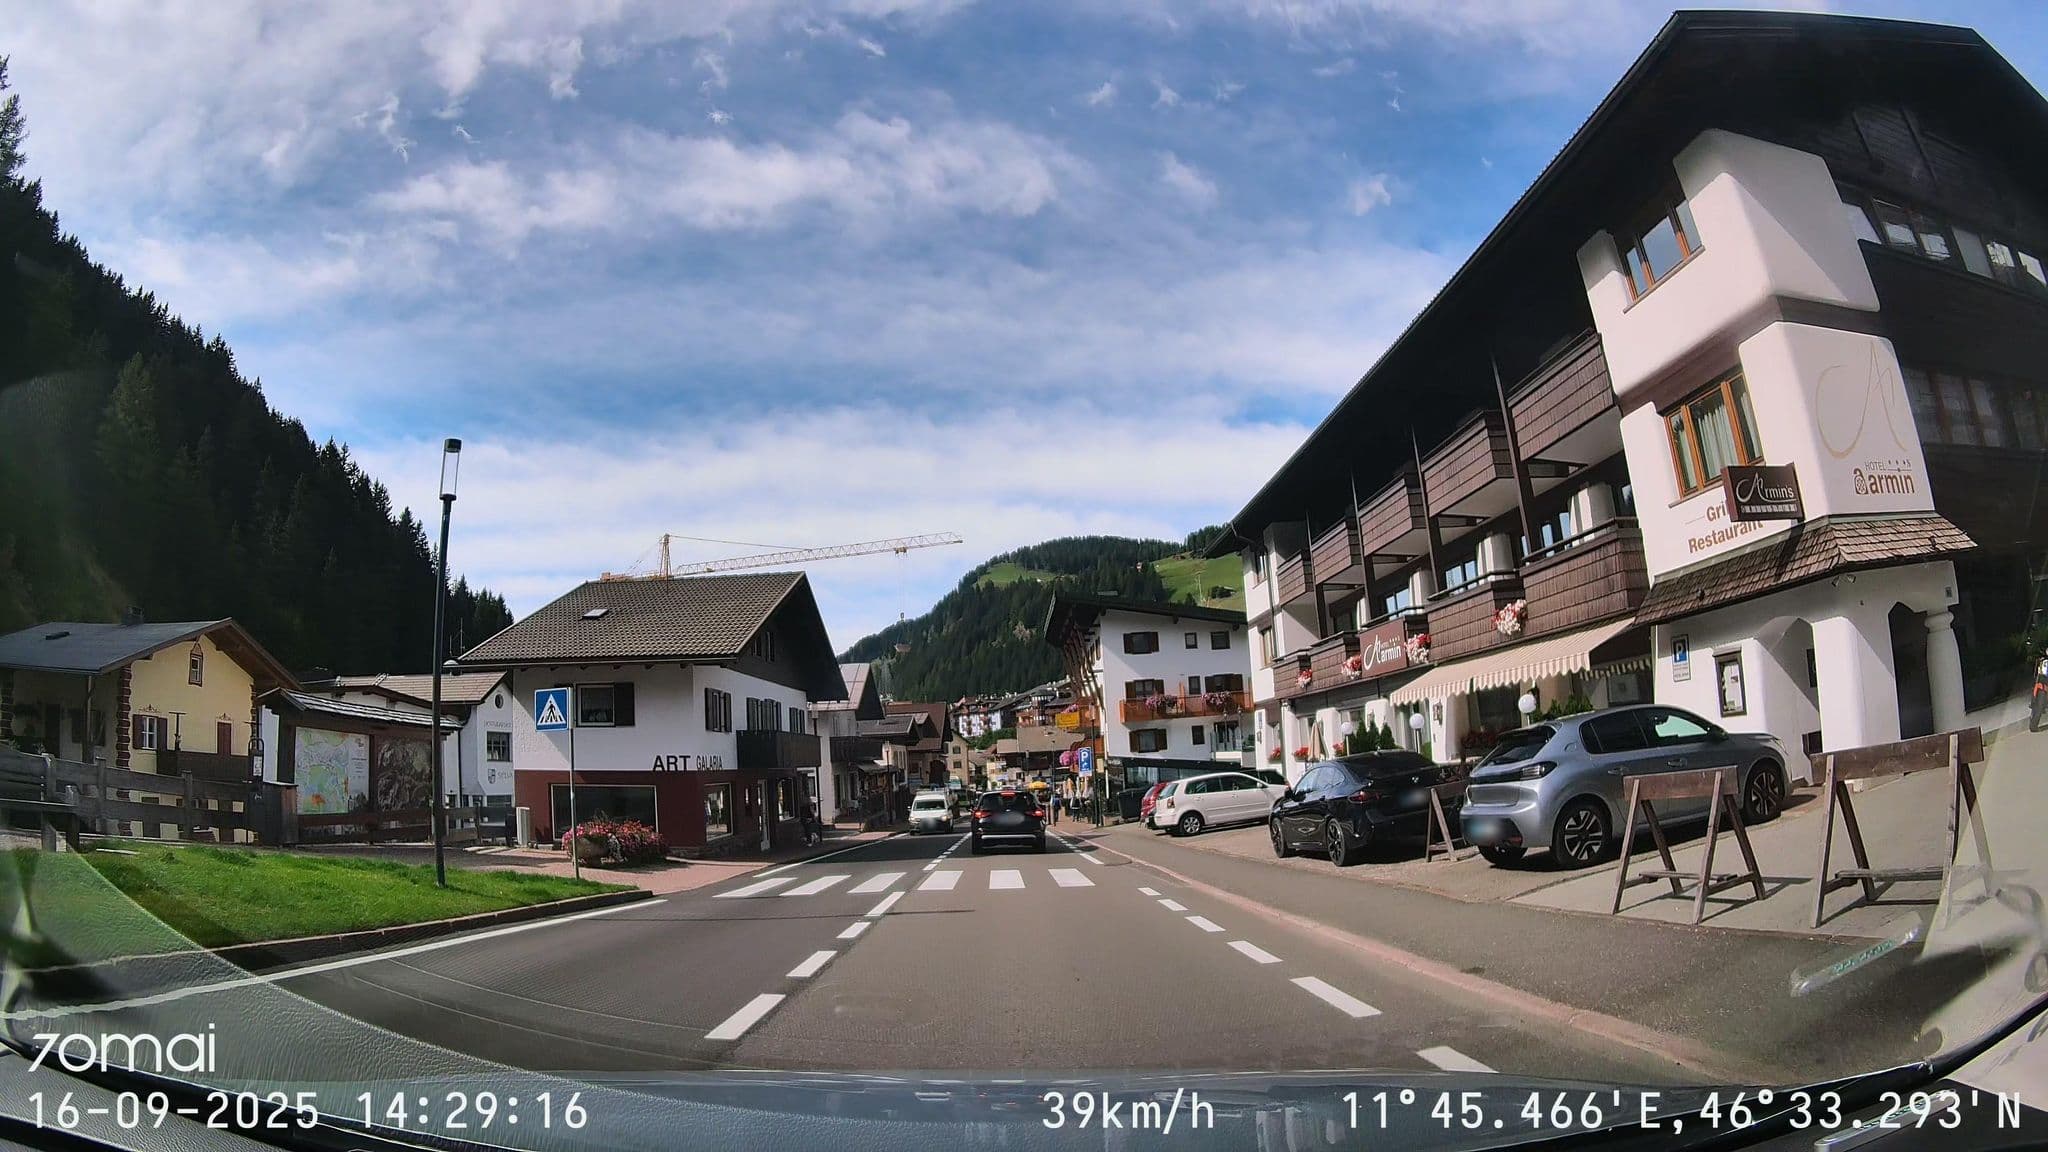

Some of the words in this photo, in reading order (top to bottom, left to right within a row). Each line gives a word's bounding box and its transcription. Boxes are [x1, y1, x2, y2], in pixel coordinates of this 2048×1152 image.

[1864, 461, 1886, 471] HOTEL
[1868, 473, 1915, 494] armin
[1706, 500, 1727, 521] Gri
[652, 755, 691, 772] ART
[1081, 751, 1089, 762] P
